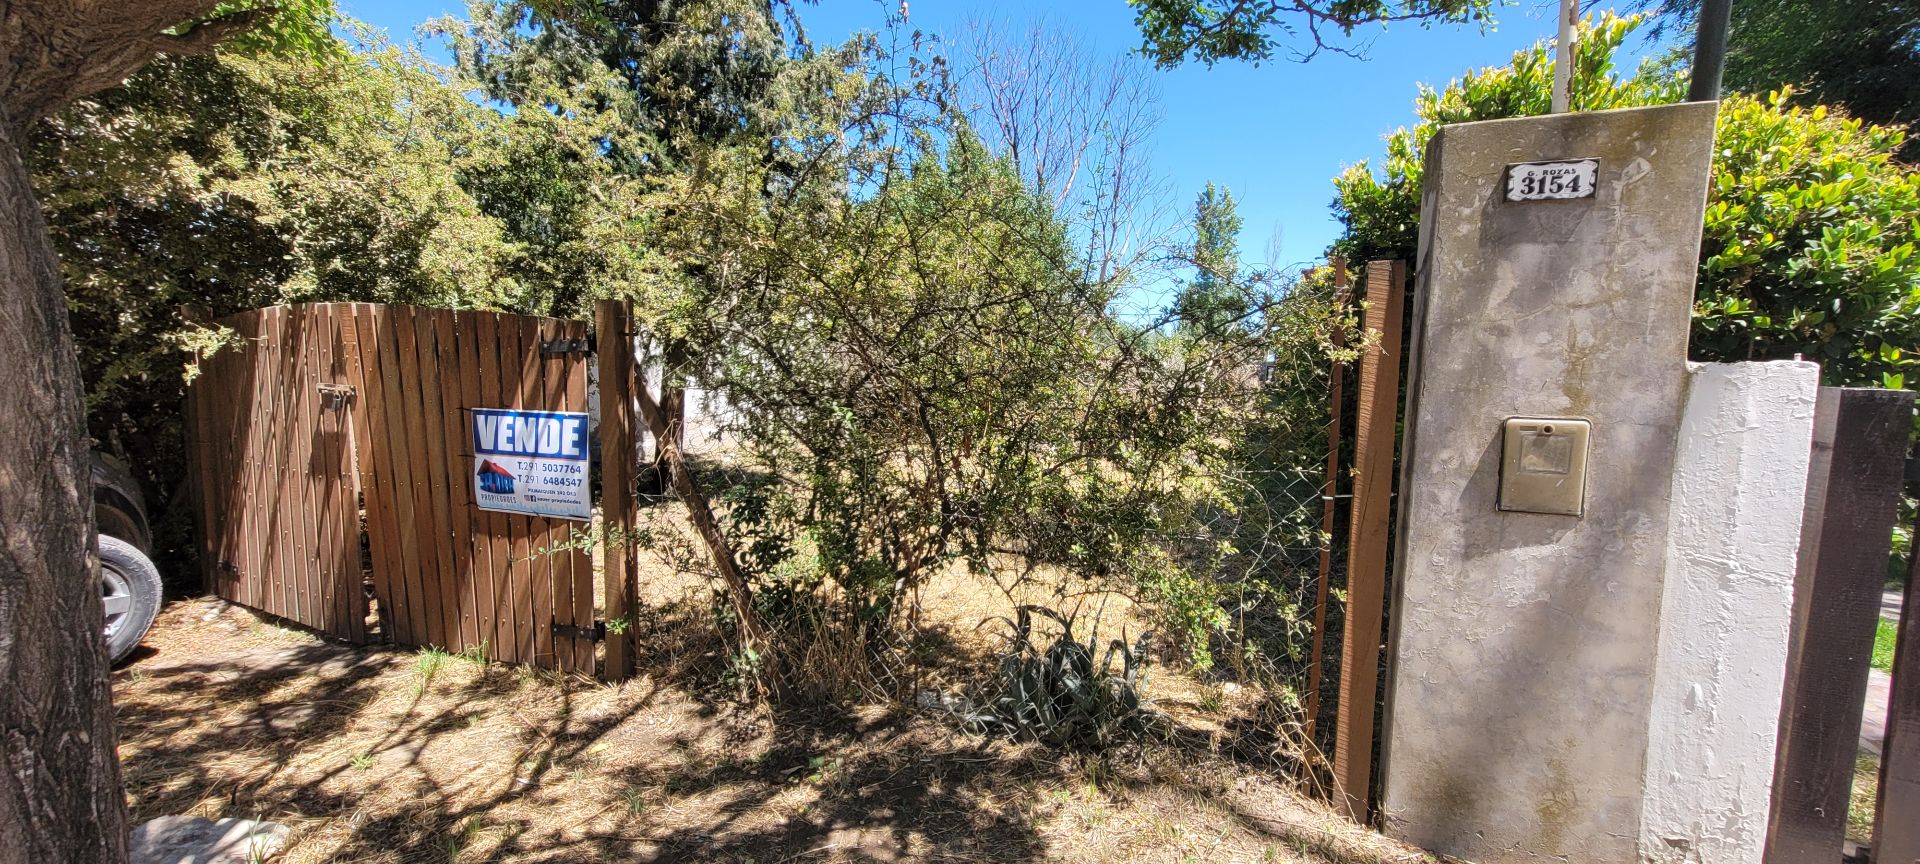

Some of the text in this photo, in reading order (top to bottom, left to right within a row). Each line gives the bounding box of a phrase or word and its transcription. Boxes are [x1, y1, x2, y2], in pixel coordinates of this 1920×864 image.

[1542, 168, 1577, 176] ROZAS
[1520, 174, 1581, 195] 3154
[476, 415, 580, 456] VENDE
[517, 461, 582, 474] T.291 5037764
[517, 474, 539, 484] T.291
[543, 476, 583, 487] 6484547
